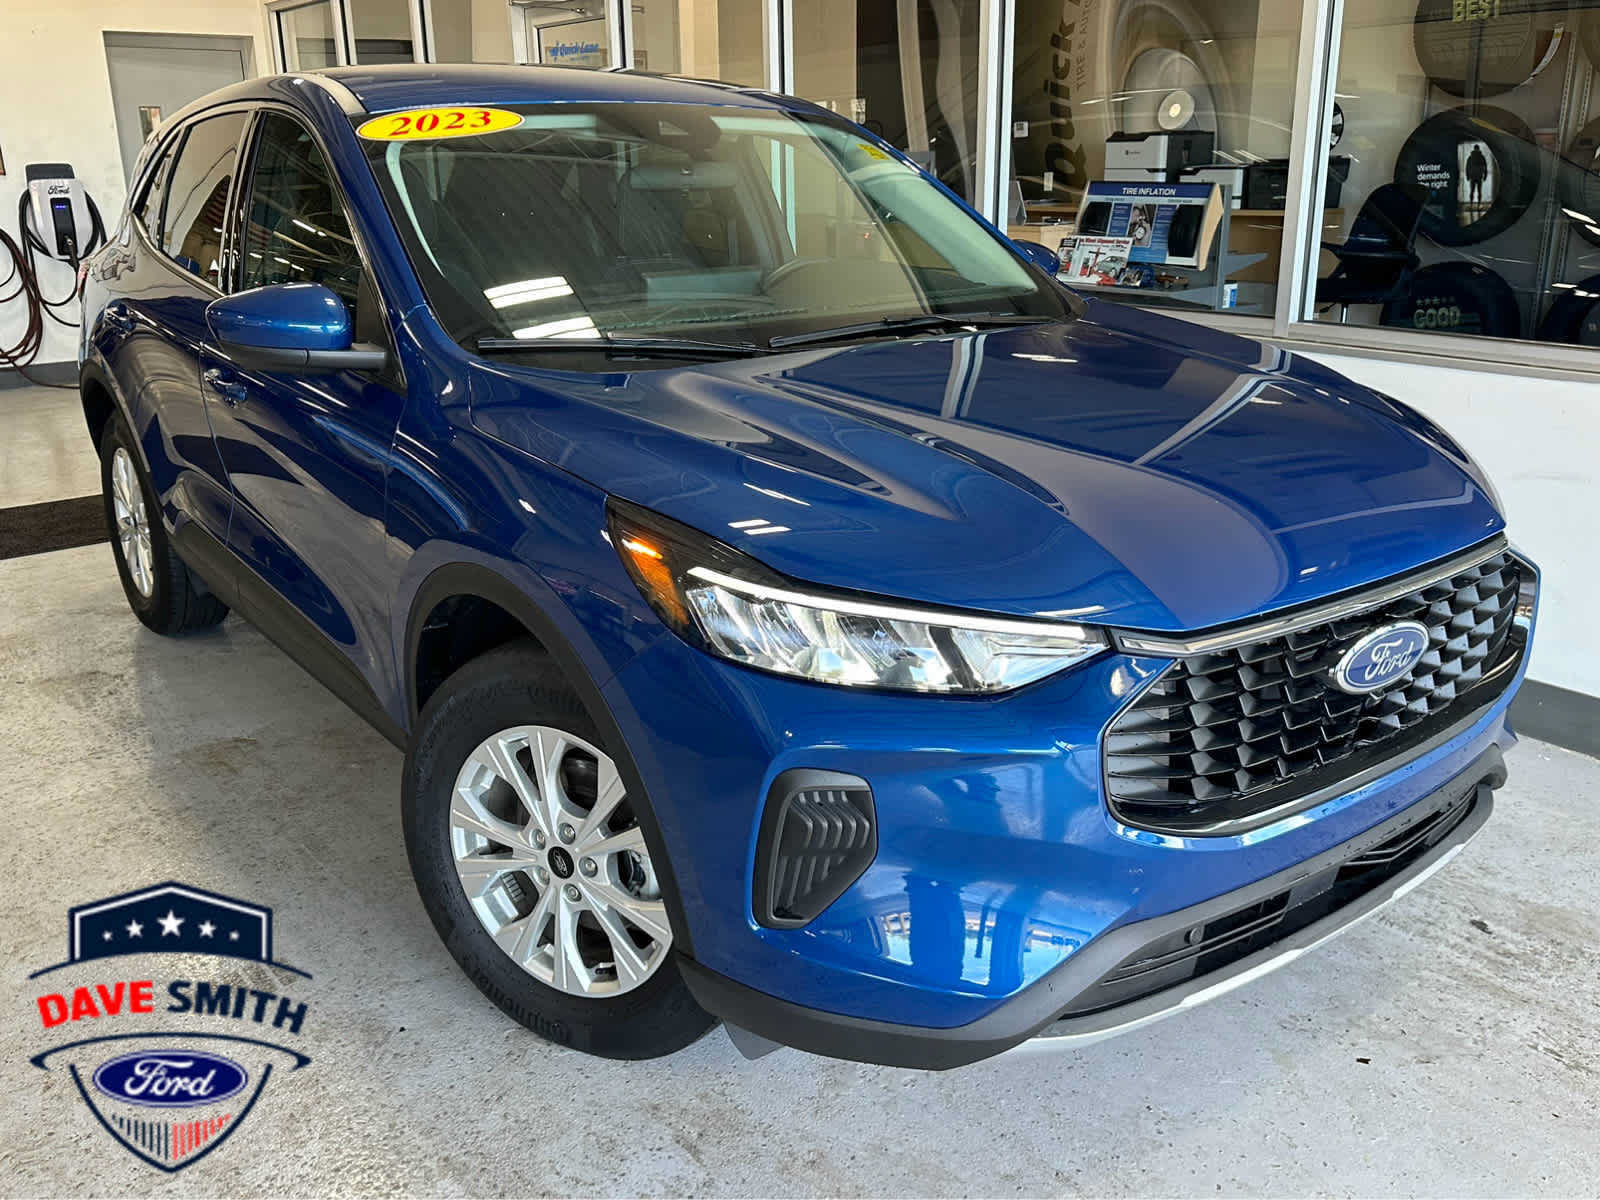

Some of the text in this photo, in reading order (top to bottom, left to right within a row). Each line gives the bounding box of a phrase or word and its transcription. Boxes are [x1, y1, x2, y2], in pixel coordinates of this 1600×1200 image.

[1043, 16, 1088, 190] Quick
[388, 110, 492, 137] 2023
[1416, 162, 1441, 172] Winter
[1417, 171, 1450, 181] demands
[1431, 180, 1449, 189] right
[47, 185, 71, 195] Ford
[1122, 187, 1177, 196] TIRE INFLATION
[1414, 306, 1461, 329] GOOD
[1364, 638, 1414, 680] Ford
